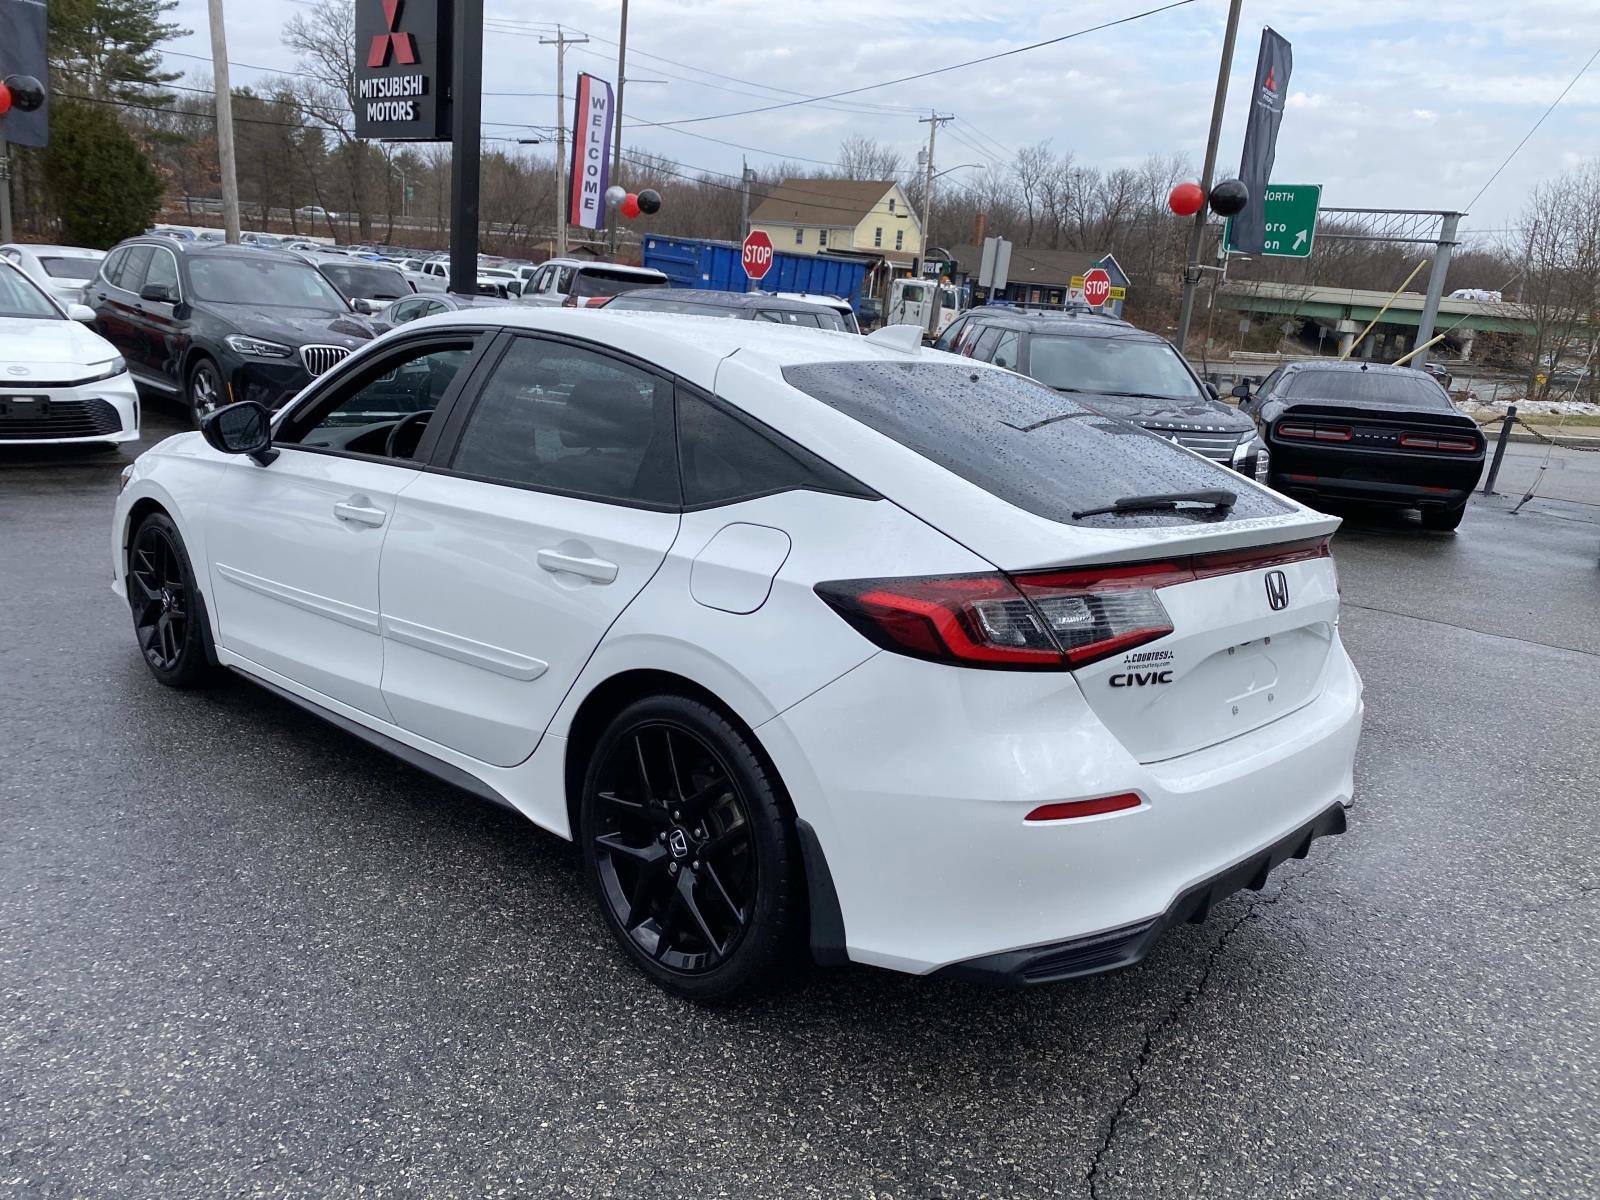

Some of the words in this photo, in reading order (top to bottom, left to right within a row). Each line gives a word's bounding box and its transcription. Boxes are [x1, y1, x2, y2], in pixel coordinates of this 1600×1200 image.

[359, 74, 423, 98] MITSUBISHI
[366, 100, 414, 122] MOTORS
[583, 96, 606, 210] WELCOME
[744, 244, 771, 265] STOP
[1085, 280, 1109, 295] STOP
[1109, 670, 1174, 688] CIVIC
